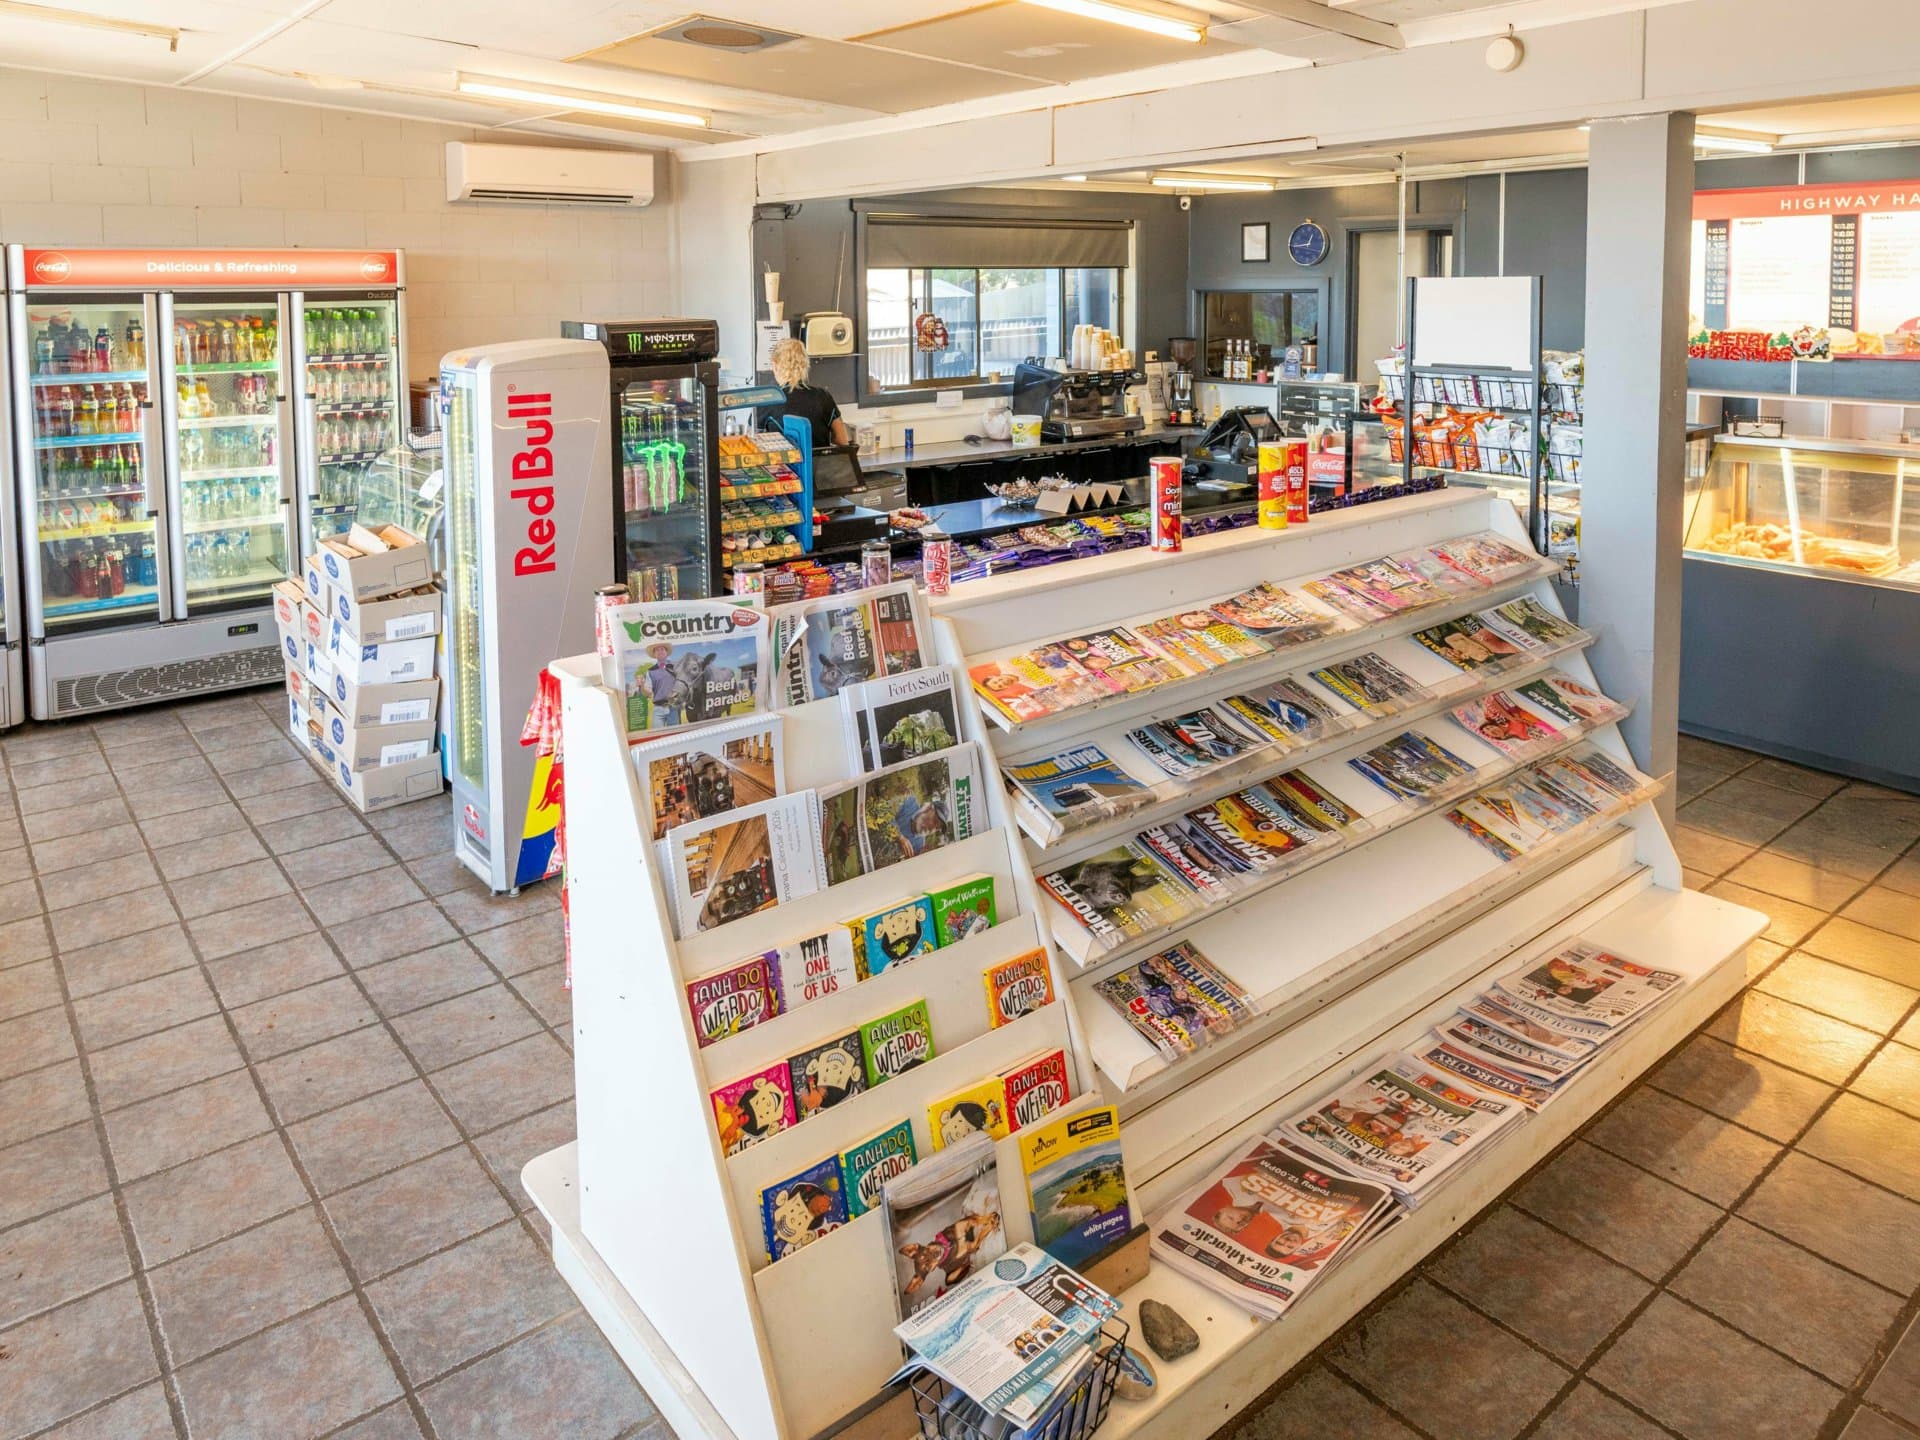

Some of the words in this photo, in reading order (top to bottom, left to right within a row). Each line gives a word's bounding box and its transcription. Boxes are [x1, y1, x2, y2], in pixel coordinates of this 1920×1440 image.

[1780, 194, 1881, 210] HIGHWAY
[147, 261, 210, 273] Delicious
[214, 261, 225, 273] &
[227, 261, 297, 274] Refreshing
[645, 332, 696, 345] MONSTER
[1710, 331, 1772, 348] MERRY
[1688, 345, 1794, 362] CHRISTMAS
[508, 392, 555, 480] Bull
[510, 486, 556, 577] Red
[641, 612, 736, 637] country
[648, 612, 687, 622] TASMANIAN
[842, 627, 855, 661] Beef
[858, 612, 870, 659] parade
[705, 677, 737, 694] Beef
[705, 690, 751, 712] parade
[1131, 727, 1164, 756] CARS
[953, 776, 972, 841] FARM
[1197, 811, 1276, 869] CRUZIN
[805, 955, 831, 977] ONE
[995, 966, 1020, 988] ANH
[1023, 956, 1041, 976] DO
[1164, 950, 1201, 986] FEVER
[698, 978, 732, 1003] ANH
[737, 967, 760, 989] DO
[803, 982, 818, 1001] OF
[821, 975, 839, 994] US
[870, 1018, 900, 1045] ANH
[903, 1008, 923, 1030] DO
[1012, 1070, 1038, 1095] ANH
[1041, 1059, 1059, 1079] DO
[1433, 1052, 1519, 1093] MERCURY
[1367, 1078, 1411, 1102] OFF
[1408, 1094, 1465, 1126] PACE
[855, 1143, 883, 1172] ANH
[887, 1130, 907, 1153] DO
[1333, 1125, 1366, 1150] Sun
[1365, 1147, 1426, 1175] Herald
[1241, 1176, 1346, 1222] ASHES
[1300, 1177, 1330, 1198] Today
[1083, 1222, 1103, 1238] white
[1102, 1213, 1124, 1231] pages
[1190, 1226, 1253, 1265] Advocate
[1251, 1260, 1280, 1279] The
